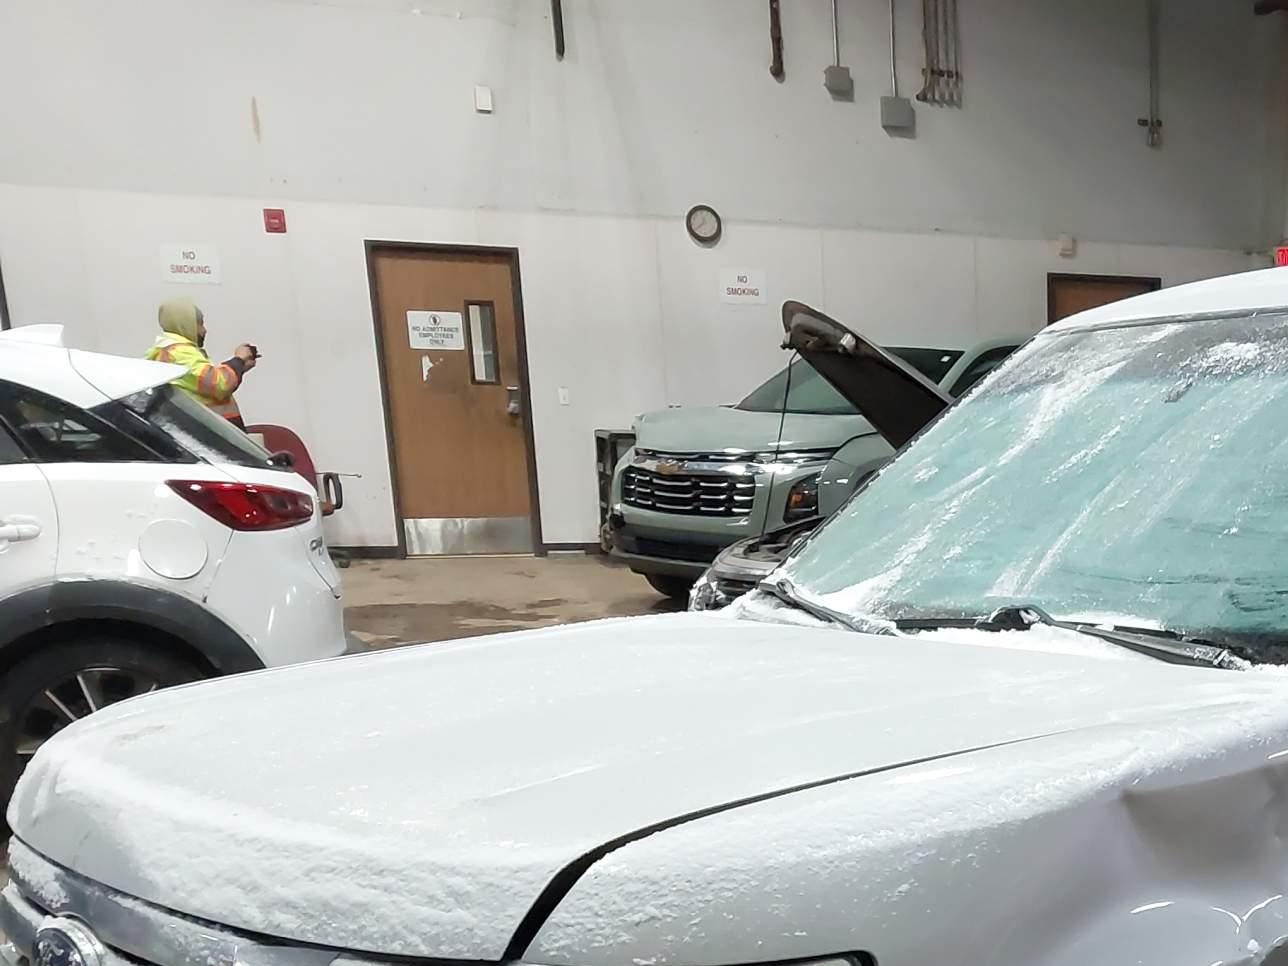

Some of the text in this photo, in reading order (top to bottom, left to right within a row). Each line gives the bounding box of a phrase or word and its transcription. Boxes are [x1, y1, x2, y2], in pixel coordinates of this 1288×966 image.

[182, 251, 196, 260] NO
[170, 264, 211, 275] SMOKING
[737, 275, 748, 284] NO
[726, 287, 760, 297] SMOKING
